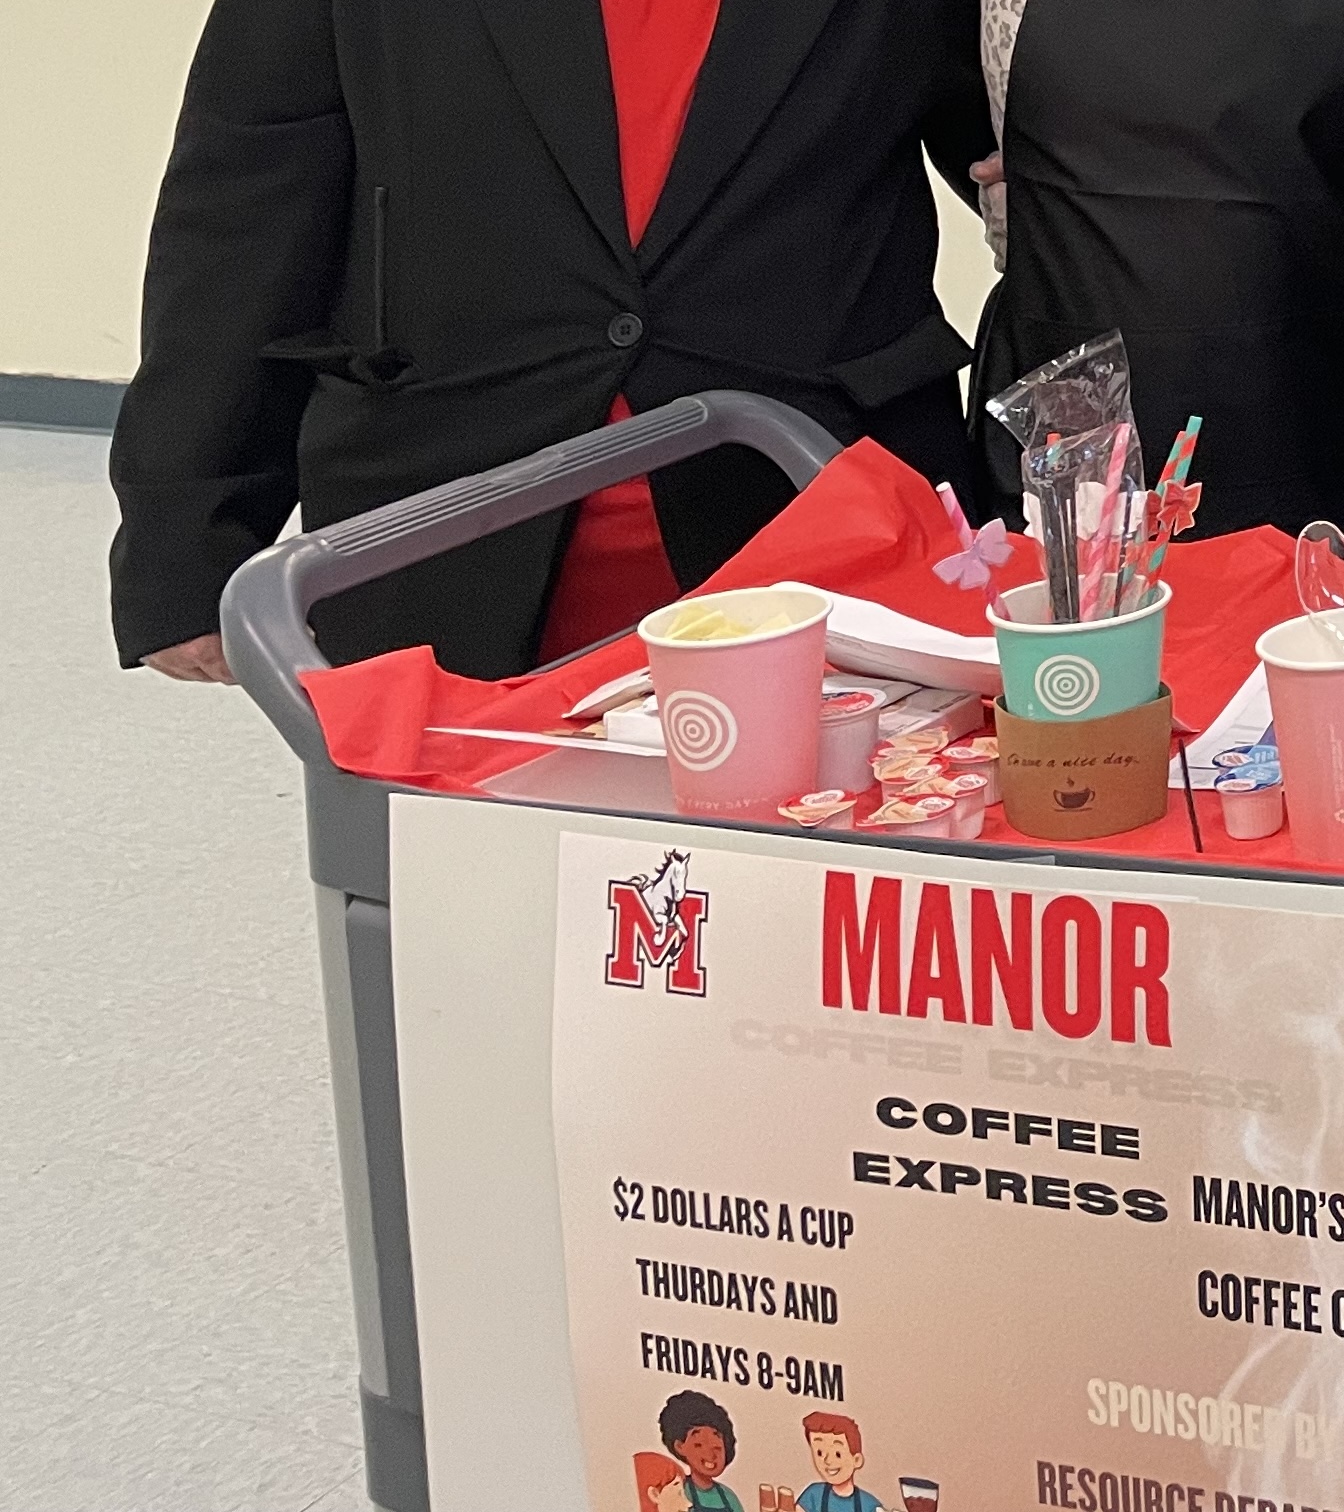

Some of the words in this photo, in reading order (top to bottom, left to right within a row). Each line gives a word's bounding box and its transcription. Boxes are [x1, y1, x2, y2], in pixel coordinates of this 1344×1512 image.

[1046, 758, 1058, 768] a
[1062, 753, 1098, 768] nice
[822, 869, 1172, 1049] MANOR
[875, 1095, 1141, 1161] COFFEE
[612, 1175, 646, 1222] $2
[651, 1185, 771, 1240] DOLLARS
[776, 1202, 795, 1243] A
[799, 1205, 855, 1250] CUP
[852, 1150, 1170, 1224] EXPRESS
[635, 1257, 778, 1317] THURDAYS
[783, 1281, 839, 1326] AND
[1197, 1268, 1324, 1336] COFFEE
[640, 1331, 751, 1387] FRIDAYS
[756, 1350, 846, 1402] 8-9AM
[1036, 1459, 1206, 1512] RESOURCE
